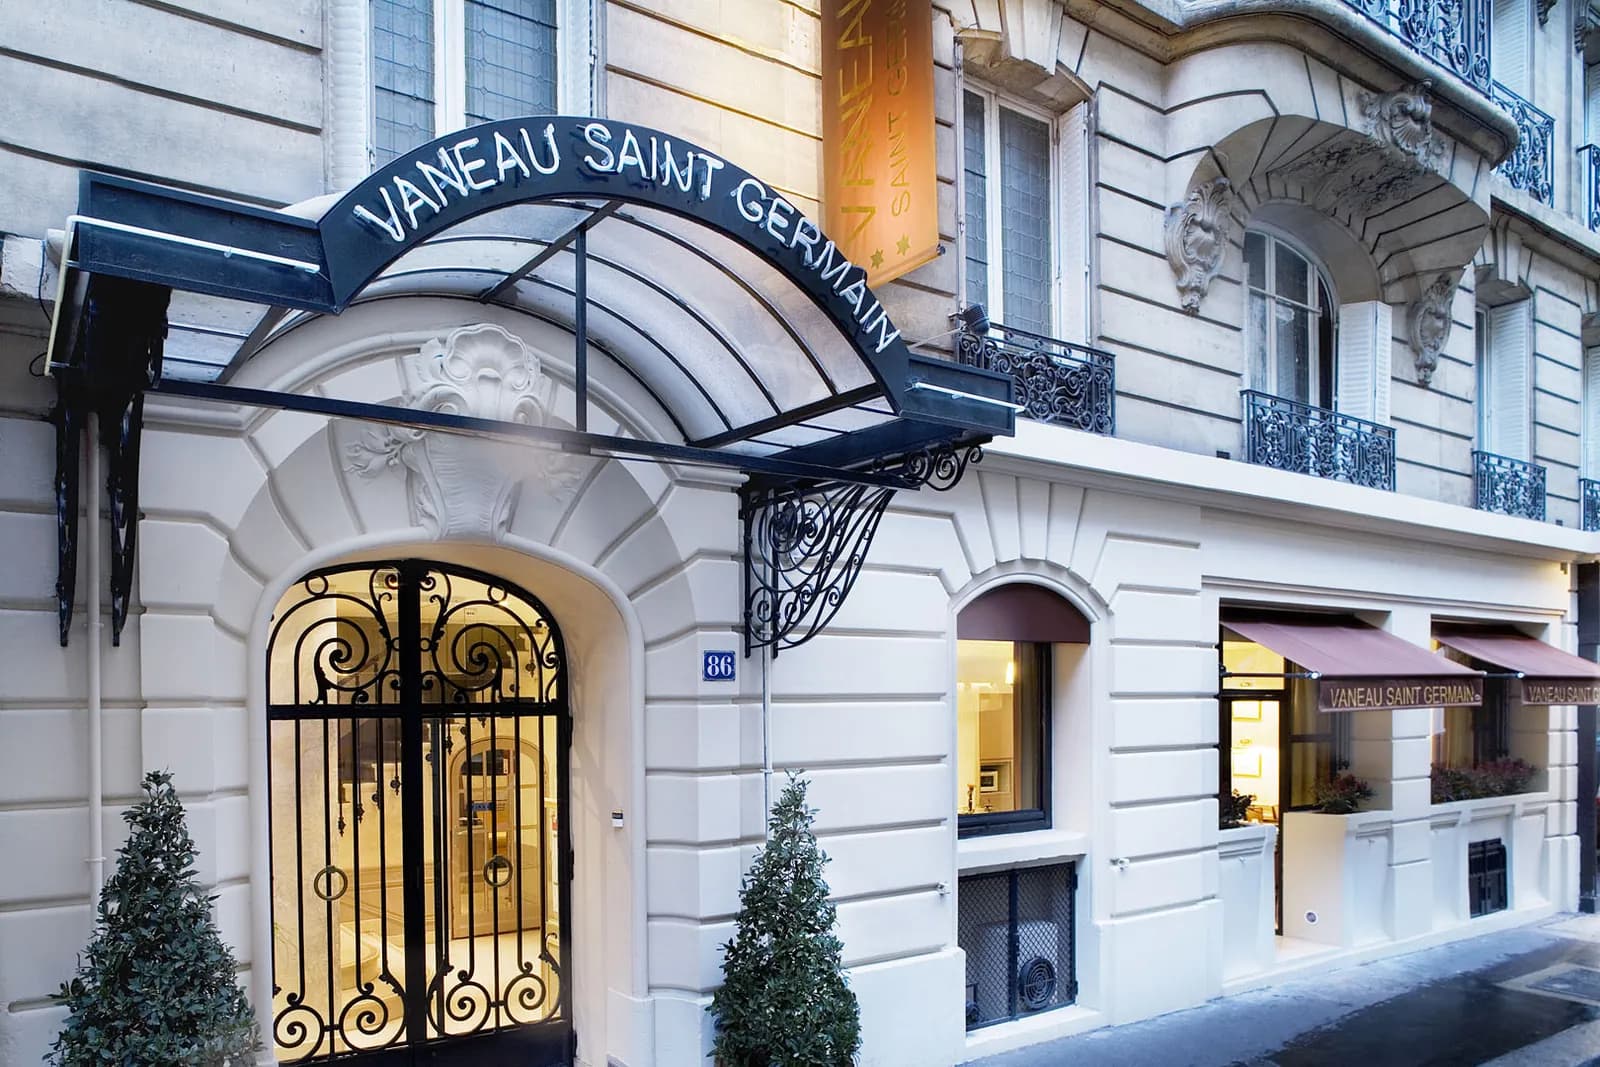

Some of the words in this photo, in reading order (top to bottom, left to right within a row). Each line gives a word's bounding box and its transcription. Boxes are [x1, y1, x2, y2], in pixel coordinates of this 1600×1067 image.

[888, 111, 911, 217] SAINT
[352, 123, 560, 242] VANEAU
[583, 122, 725, 201] SAINT
[736, 178, 901, 354] GERMAIN
[707, 655, 732, 677] 86
[1330, 687, 1383, 708] VANEAU
[1386, 686, 1421, 706] SAINT
[1423, 685, 1475, 704] GERMAIN
[1527, 686, 1566, 702] VANEAU
[1566, 687, 1592, 702] SAINT
